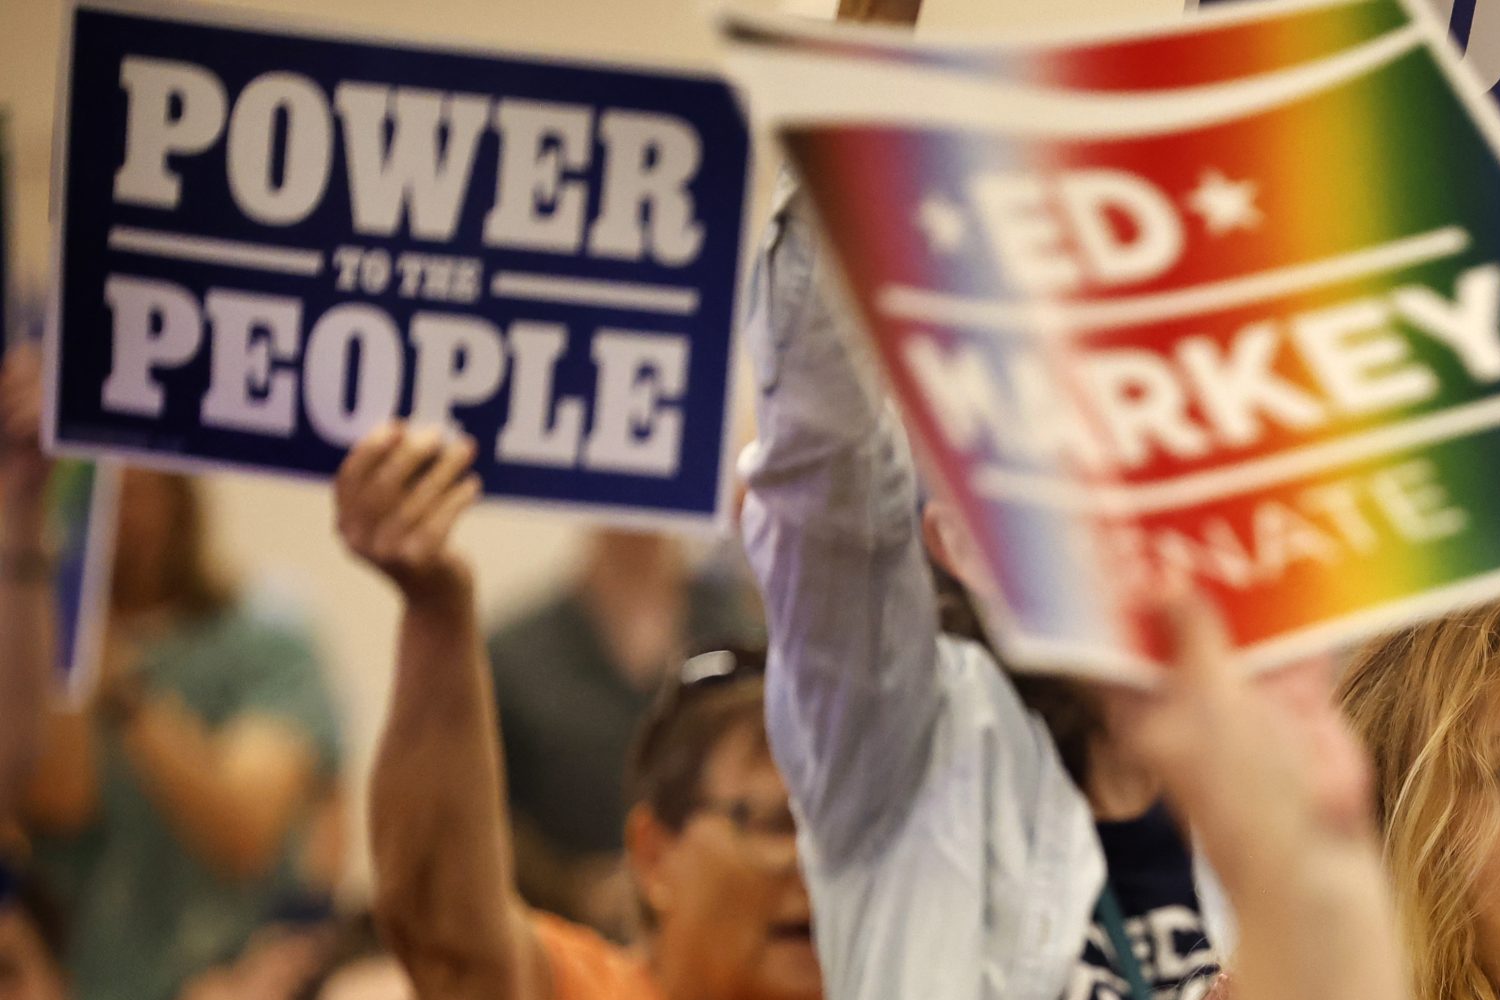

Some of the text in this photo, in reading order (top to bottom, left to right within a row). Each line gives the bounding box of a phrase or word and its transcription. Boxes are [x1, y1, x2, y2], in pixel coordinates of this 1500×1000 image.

[112, 54, 704, 268] POWER
[967, 166, 1184, 295] ED
[334, 245, 484, 303] TO THE
[102, 273, 691, 478] PEOPLE
